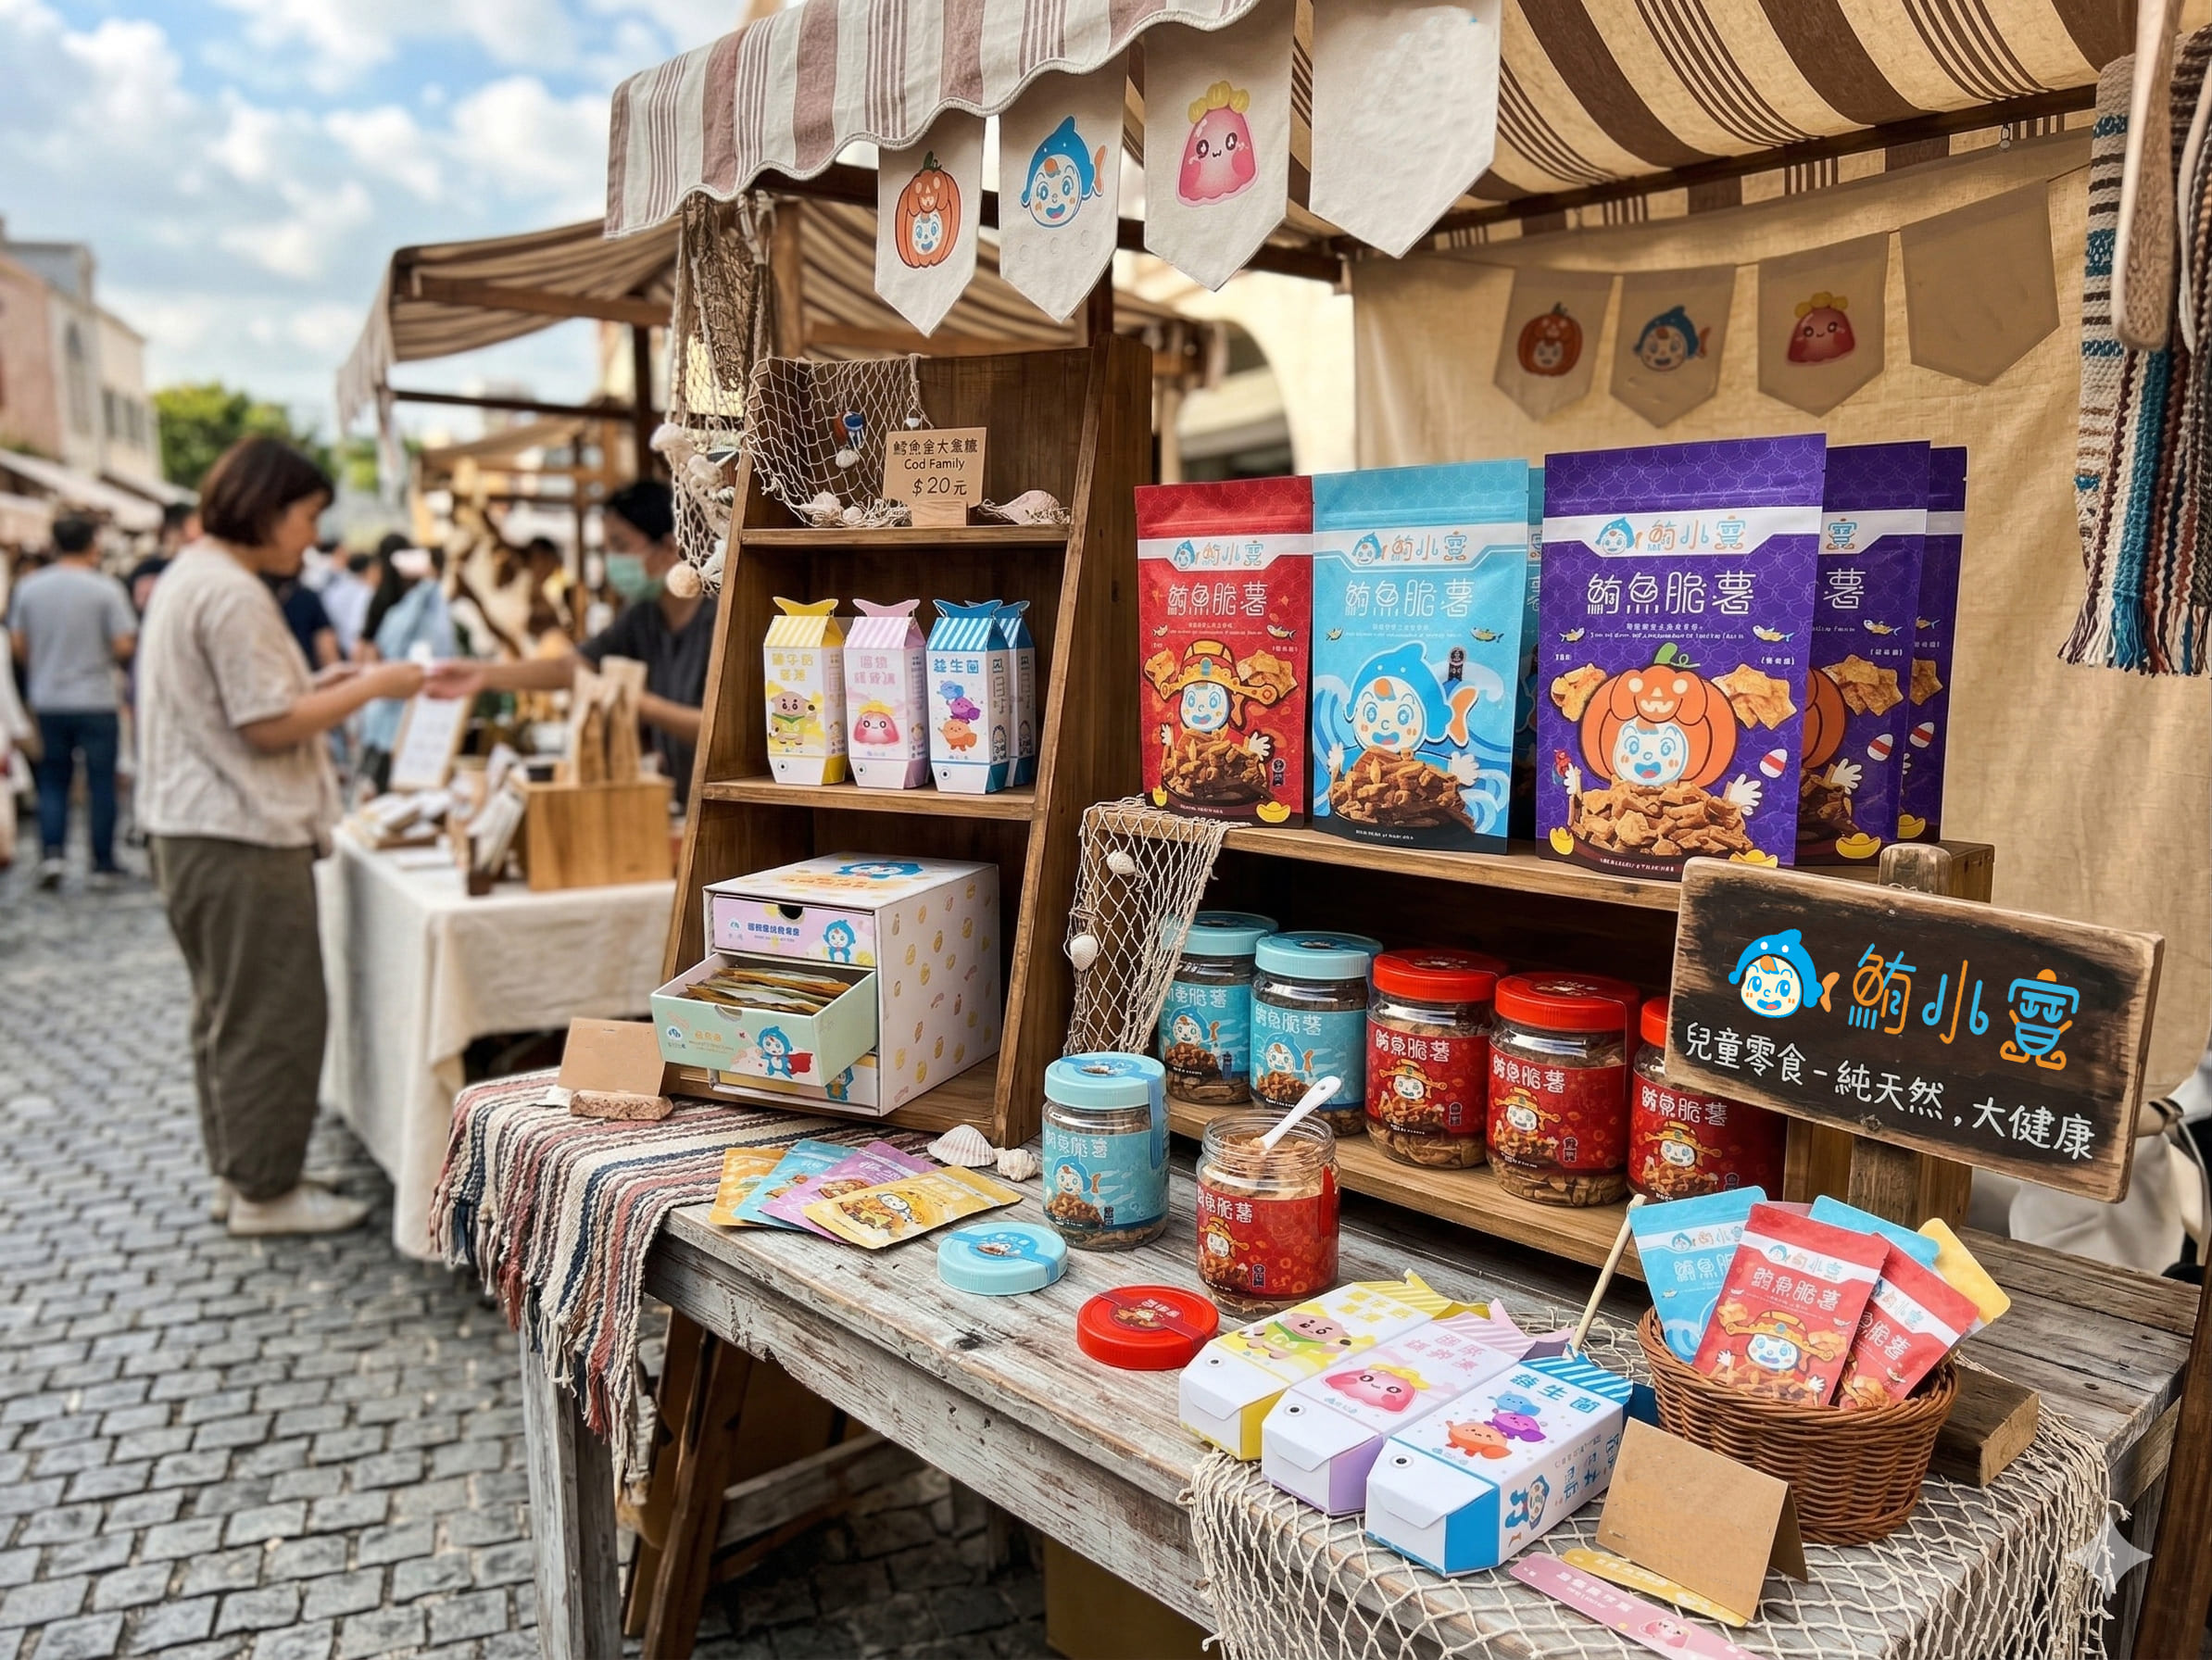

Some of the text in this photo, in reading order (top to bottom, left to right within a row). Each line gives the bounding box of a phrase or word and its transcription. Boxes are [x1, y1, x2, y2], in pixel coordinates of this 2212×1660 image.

[904, 458, 965, 471] Cod Family
[1167, 580, 1268, 616] 鮪魚脆薯
[1345, 577, 1475, 617] 鮪魚脆薯
[1587, 570, 1756, 615] 鮪魚脆薯
